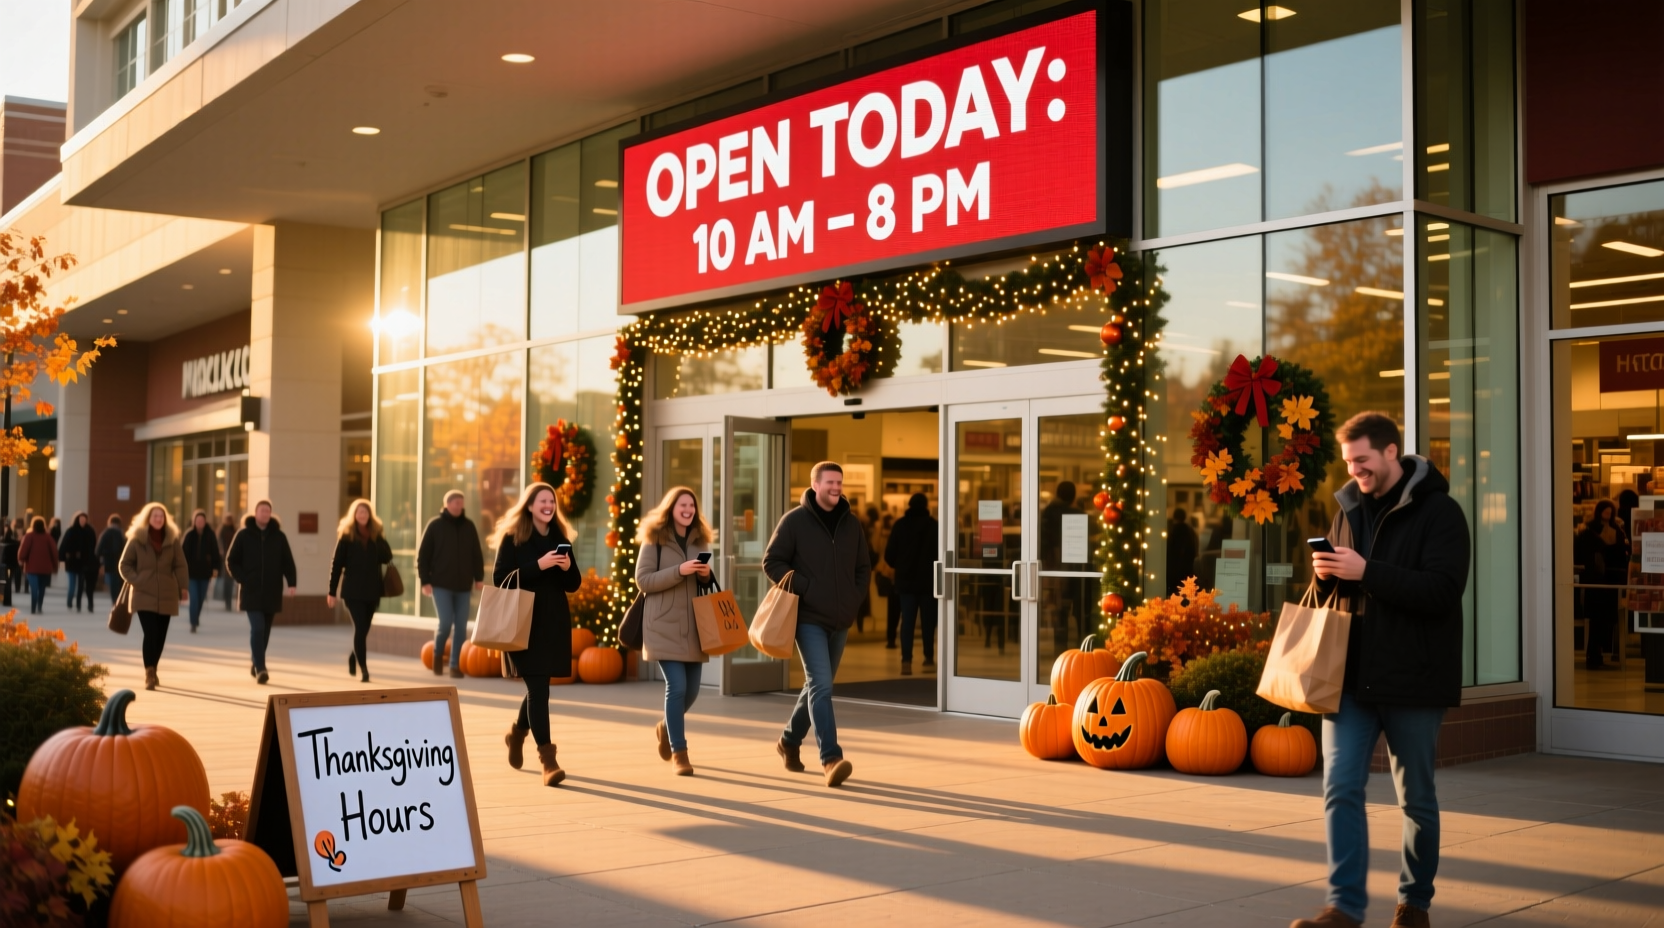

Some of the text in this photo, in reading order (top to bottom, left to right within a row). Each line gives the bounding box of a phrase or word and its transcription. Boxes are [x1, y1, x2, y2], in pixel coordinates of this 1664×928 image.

[645, 46, 1067, 218] OPEN TODAY:
[692, 218, 736, 274] 10
[744, 200, 815, 266] AM
[866, 182, 896, 241] 8
[911, 161, 991, 234] PM
[297, 726, 455, 787] Thanksgiving
[340, 789, 435, 842] Hours
